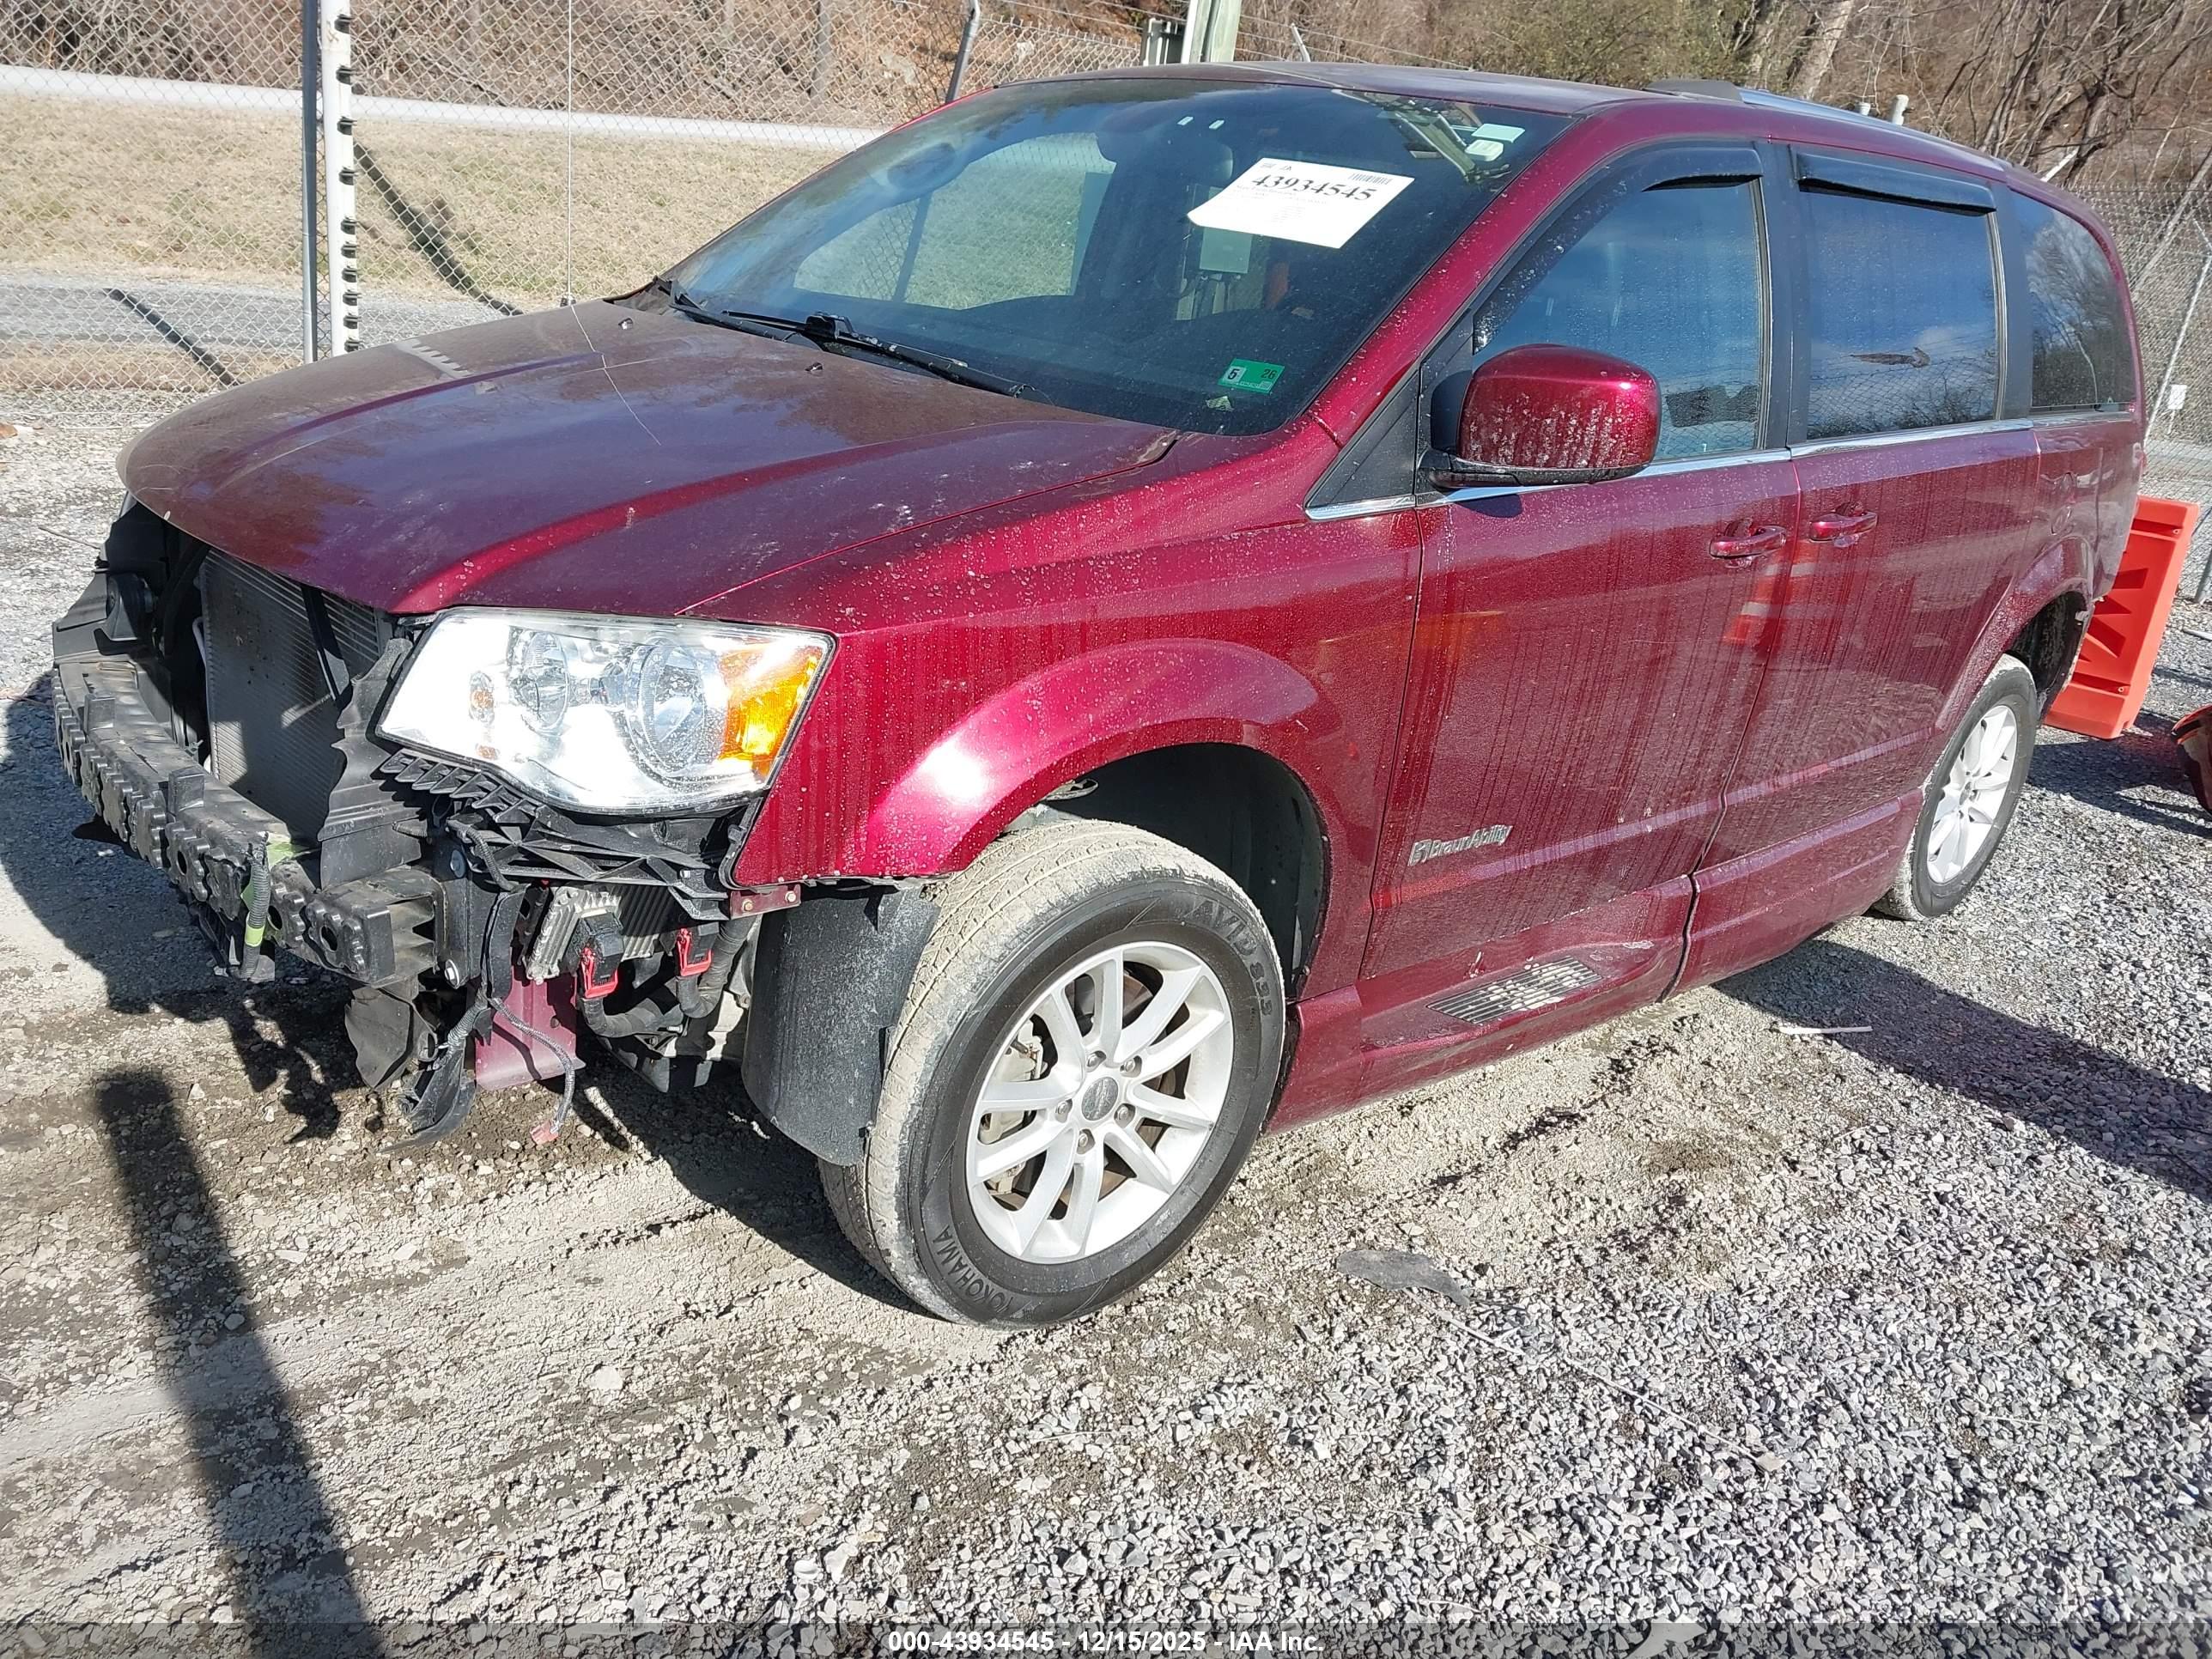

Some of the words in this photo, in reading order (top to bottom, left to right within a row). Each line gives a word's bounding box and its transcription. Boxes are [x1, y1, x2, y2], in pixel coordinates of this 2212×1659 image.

[1253, 174, 1376, 200] 43934545
[1228, 368, 1239, 380] 5
[1261, 369, 1277, 380] 26
[1430, 824, 1513, 858] BraunAbility
[933, 1224, 1014, 1314] YOKOHAMA
